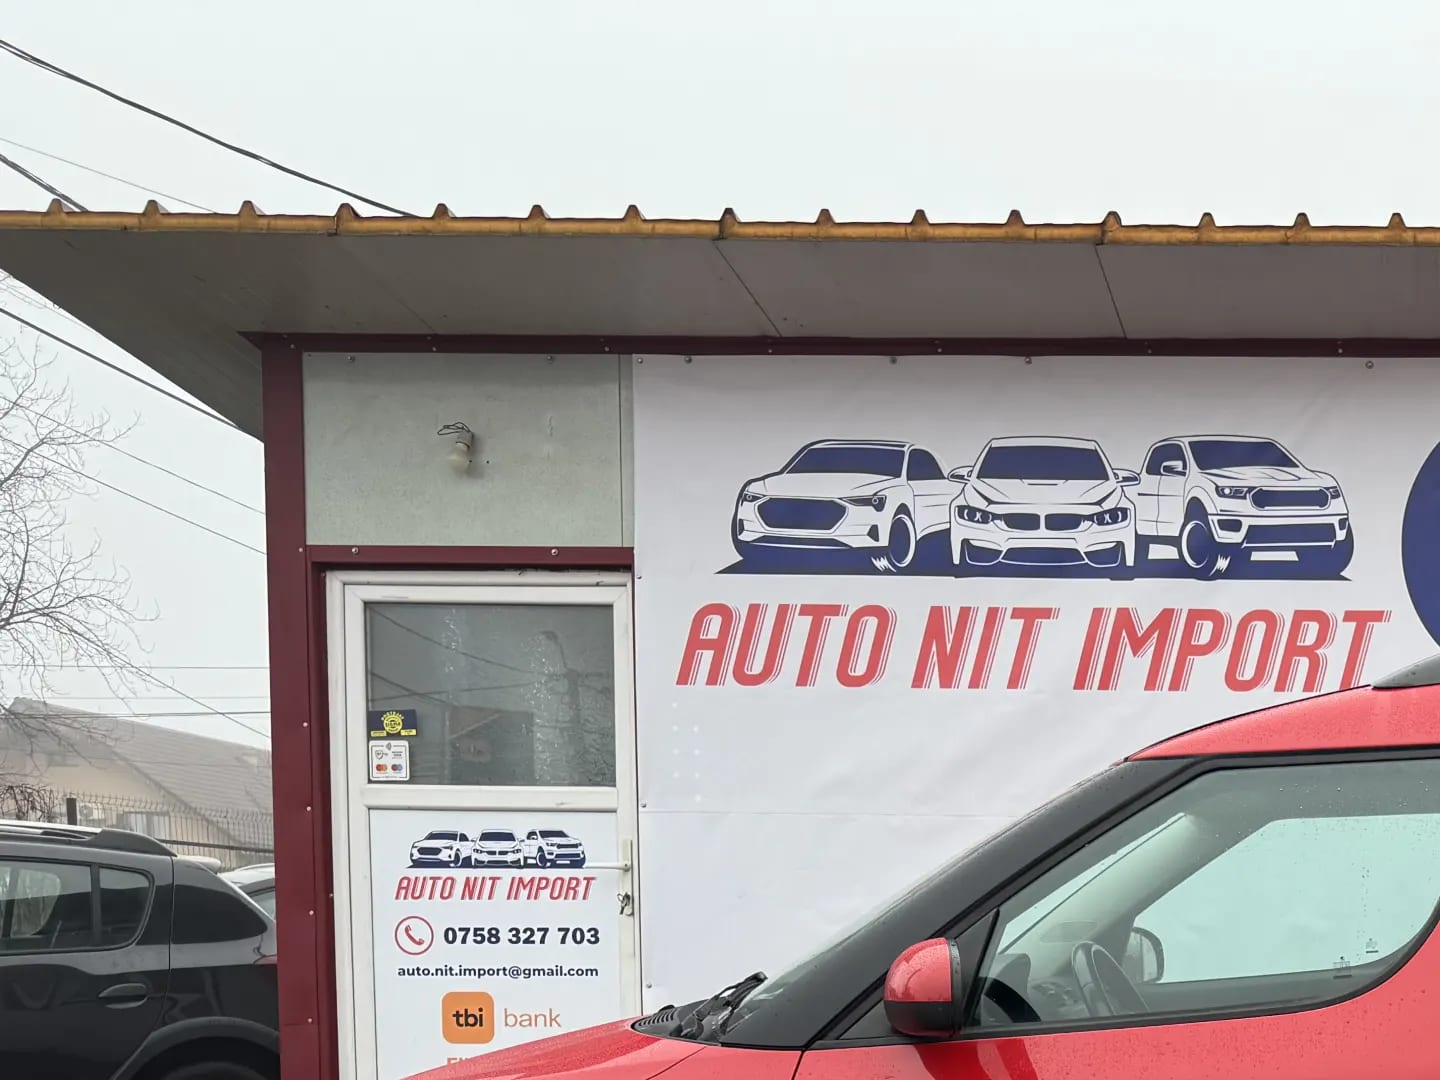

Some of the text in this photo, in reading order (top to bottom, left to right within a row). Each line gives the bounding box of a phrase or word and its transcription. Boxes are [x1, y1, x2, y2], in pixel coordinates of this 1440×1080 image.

[675, 602, 1392, 693] AUTO NIT IMPORT
[394, 876, 598, 901] AUTO NIT IMPORT
[443, 927, 600, 945] 0758 327 703
[397, 964, 599, 979] auto.nit.import@gmail.com
[452, 1007, 563, 1028] tbi bank
